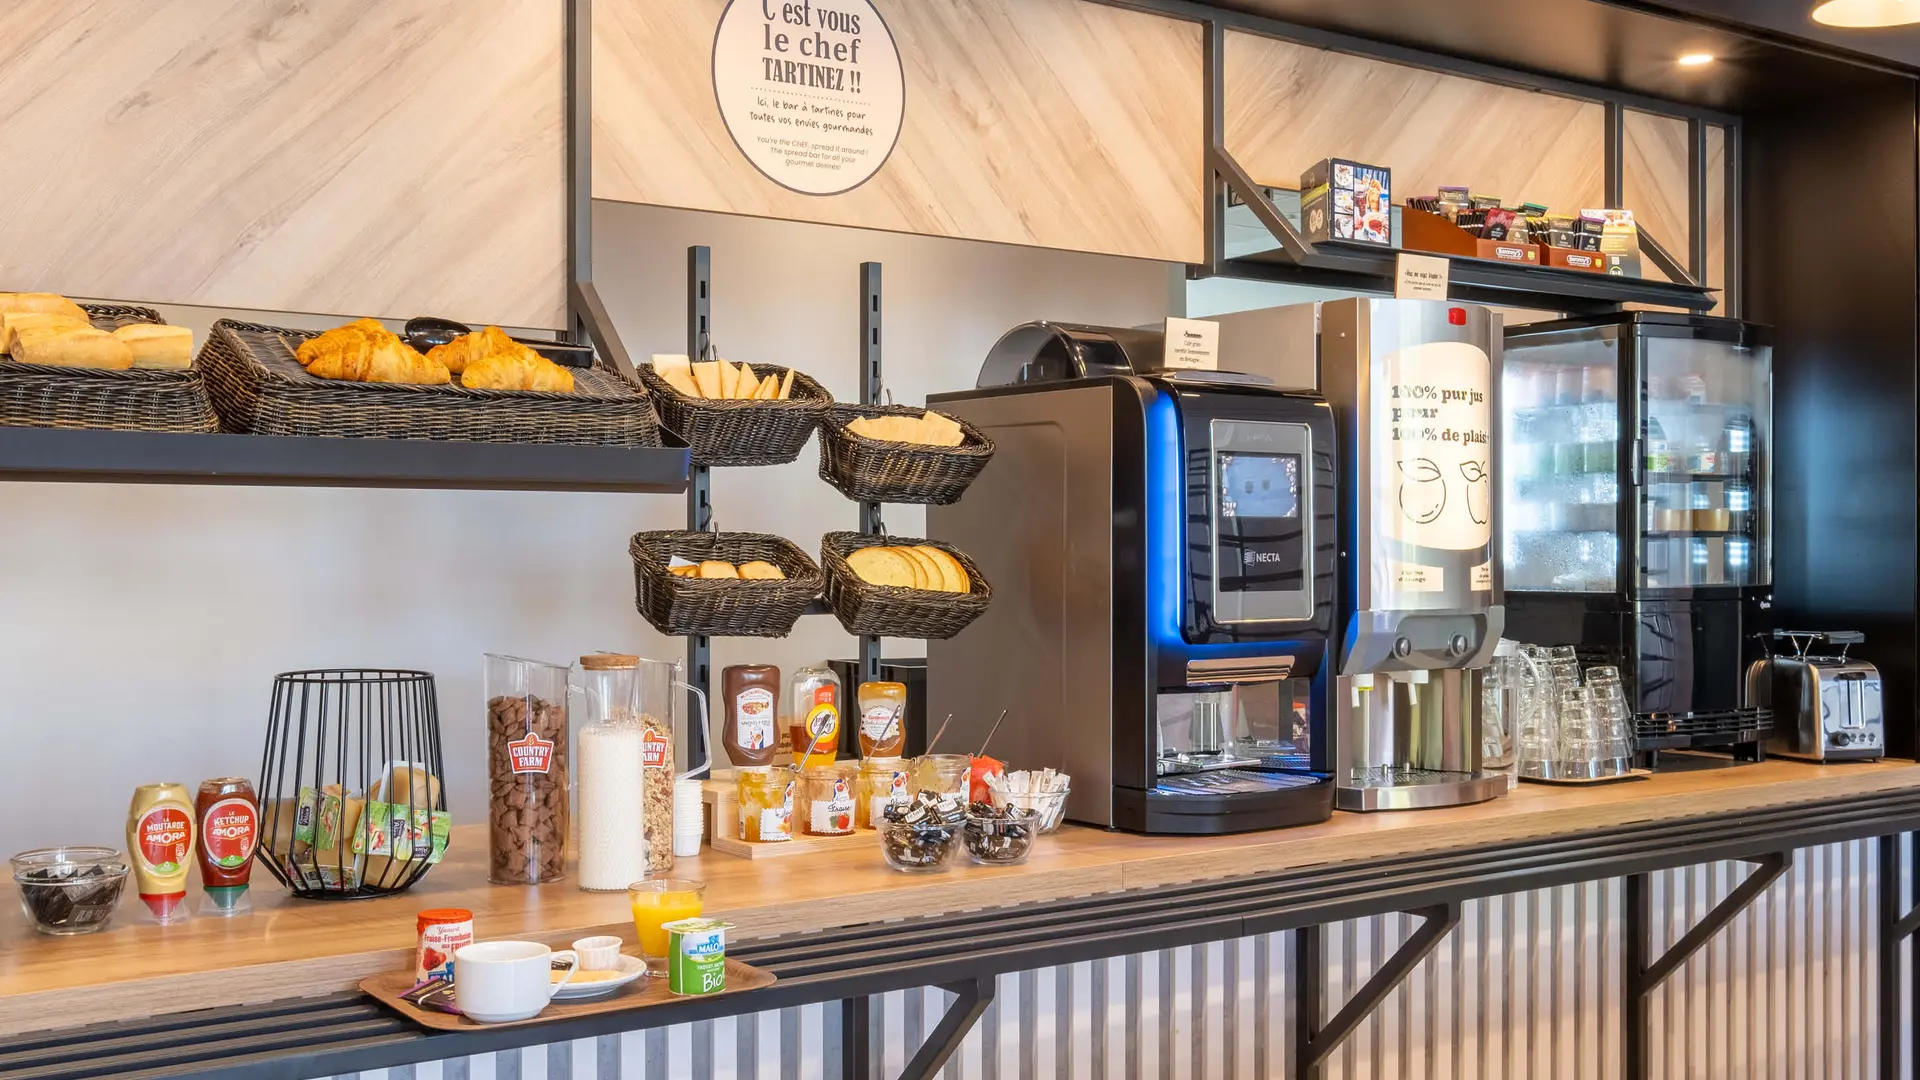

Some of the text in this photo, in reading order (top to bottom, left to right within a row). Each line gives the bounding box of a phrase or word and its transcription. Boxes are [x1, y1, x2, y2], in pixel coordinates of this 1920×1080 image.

[762, 0, 861, 35] Cest vous
[763, 24, 861, 64] le chef
[762, 57, 861, 94] TARTINEZ !!
[757, 96, 866, 120] Ici, le bar à tartines pour
[749, 111, 873, 136] toutes vos envies gourmandes
[1441, 388, 1467, 404] pur
[1469, 388, 1483, 405] jus
[1441, 428, 1460, 441] de
[1256, 552, 1280, 562] NECTA
[512, 745, 550, 757] COUNTRY
[643, 742, 665, 753] UNTRY
[519, 756, 543, 767] FARM
[643, 752, 659, 762] ARM
[146, 821, 185, 832] MOUTARDE
[214, 815, 249, 826] KETCHUP
[146, 831, 186, 843] AMORA
[212, 825, 250, 838] AMORA
[699, 942, 719, 953] MALO
[702, 972, 723, 993] Bio
